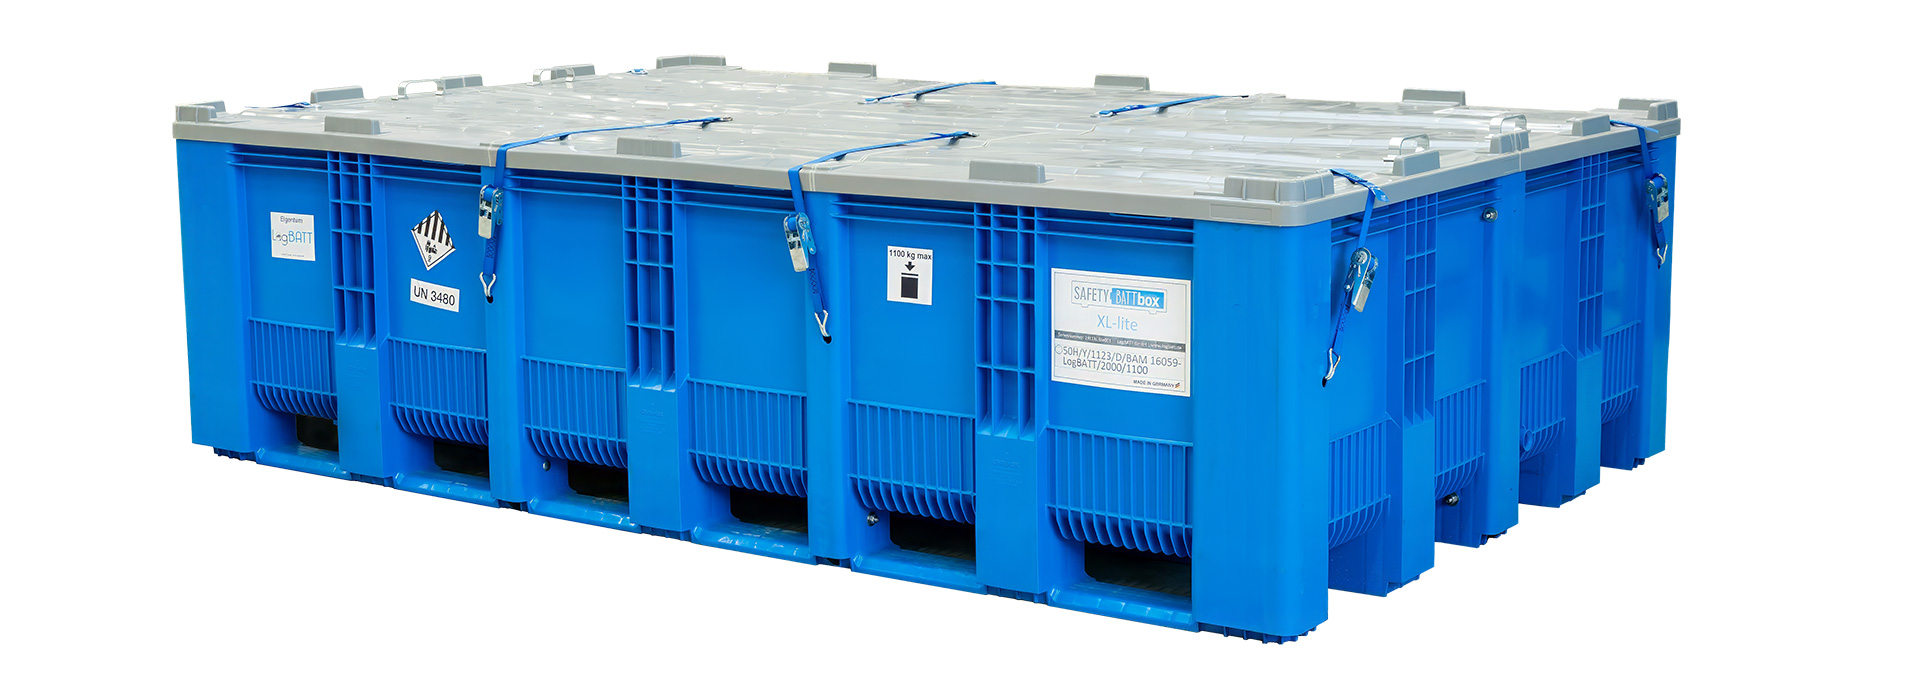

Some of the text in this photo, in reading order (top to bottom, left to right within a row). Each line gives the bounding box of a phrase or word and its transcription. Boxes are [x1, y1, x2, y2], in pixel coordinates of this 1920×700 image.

[889, 249, 905, 258] 1100
[906, 250, 916, 261] kg
[413, 285, 456, 306] UN 3480
[1073, 286, 1161, 308] SAFETY BATTbox
[1096, 314, 1139, 332] XL-lite
[1062, 356, 1149, 375] LogBATT/2000/1100
[1150, 356, 1182, 368] 16059-
